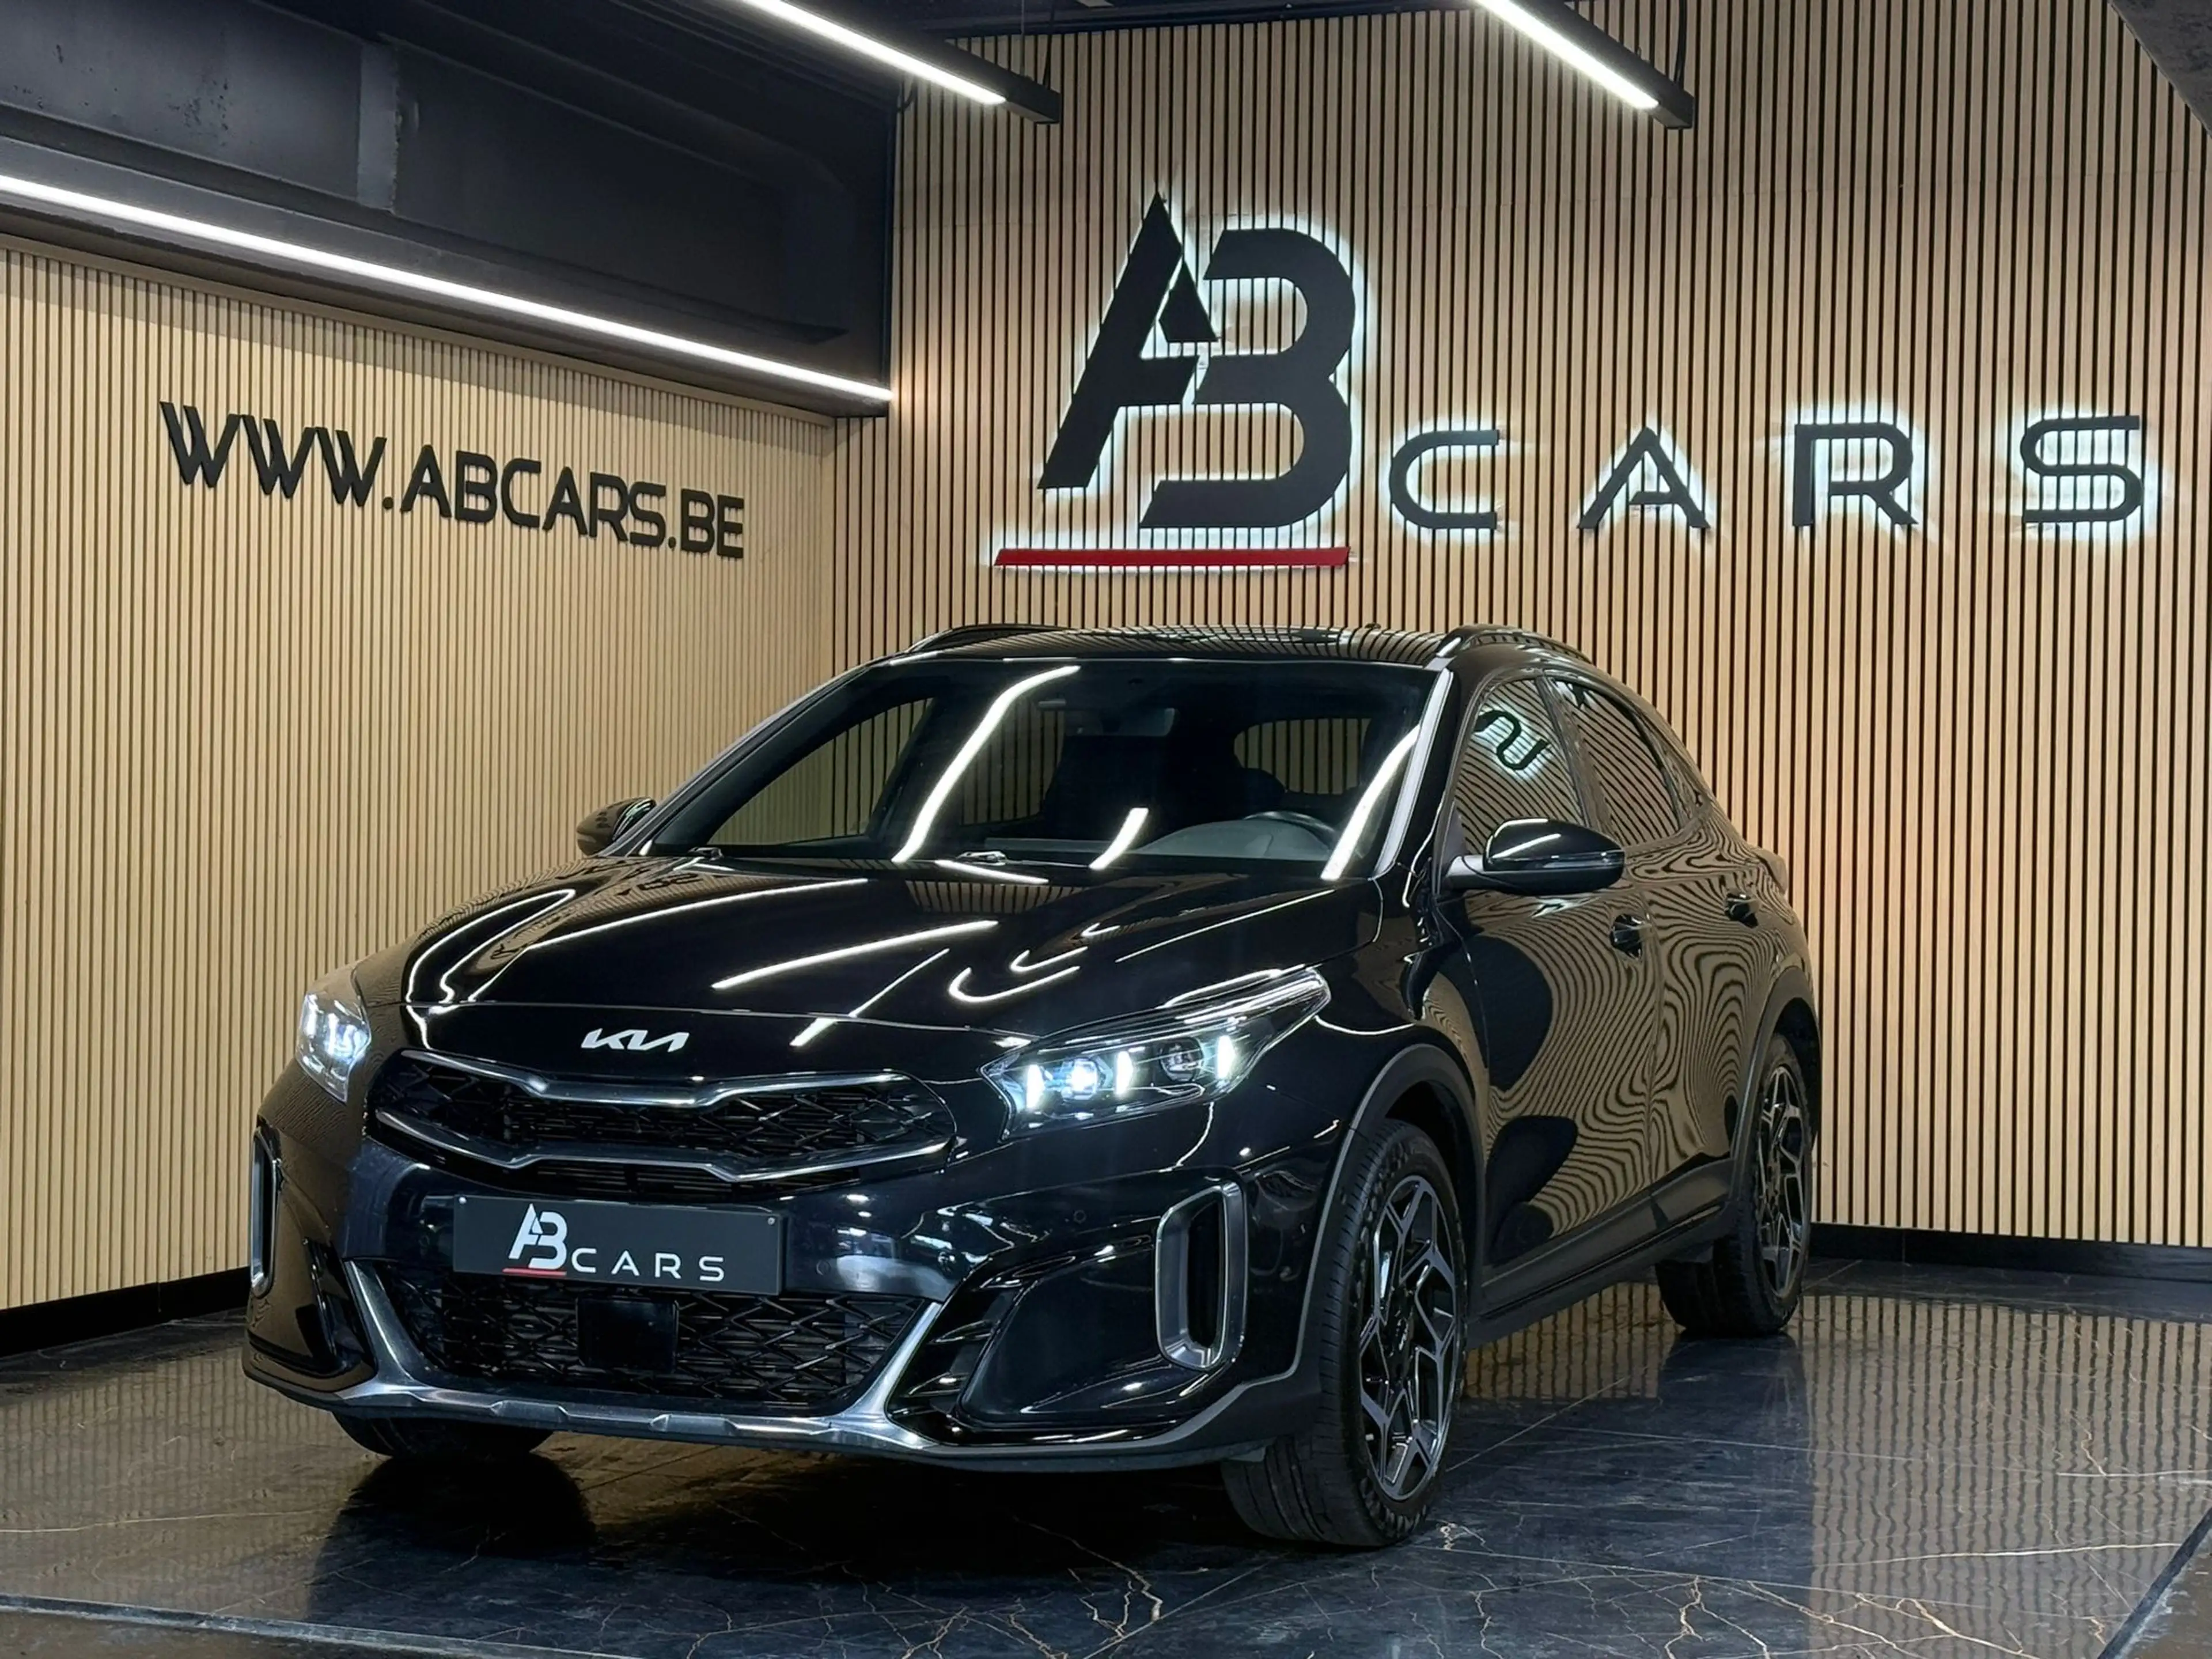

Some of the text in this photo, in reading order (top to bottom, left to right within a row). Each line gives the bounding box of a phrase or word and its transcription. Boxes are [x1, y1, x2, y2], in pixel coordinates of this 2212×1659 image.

[1036, 192, 2146, 532] AB CARS
[159, 400, 745, 559] WWW.ABCARS.BE
[507, 1203, 725, 1282] AB CARS
